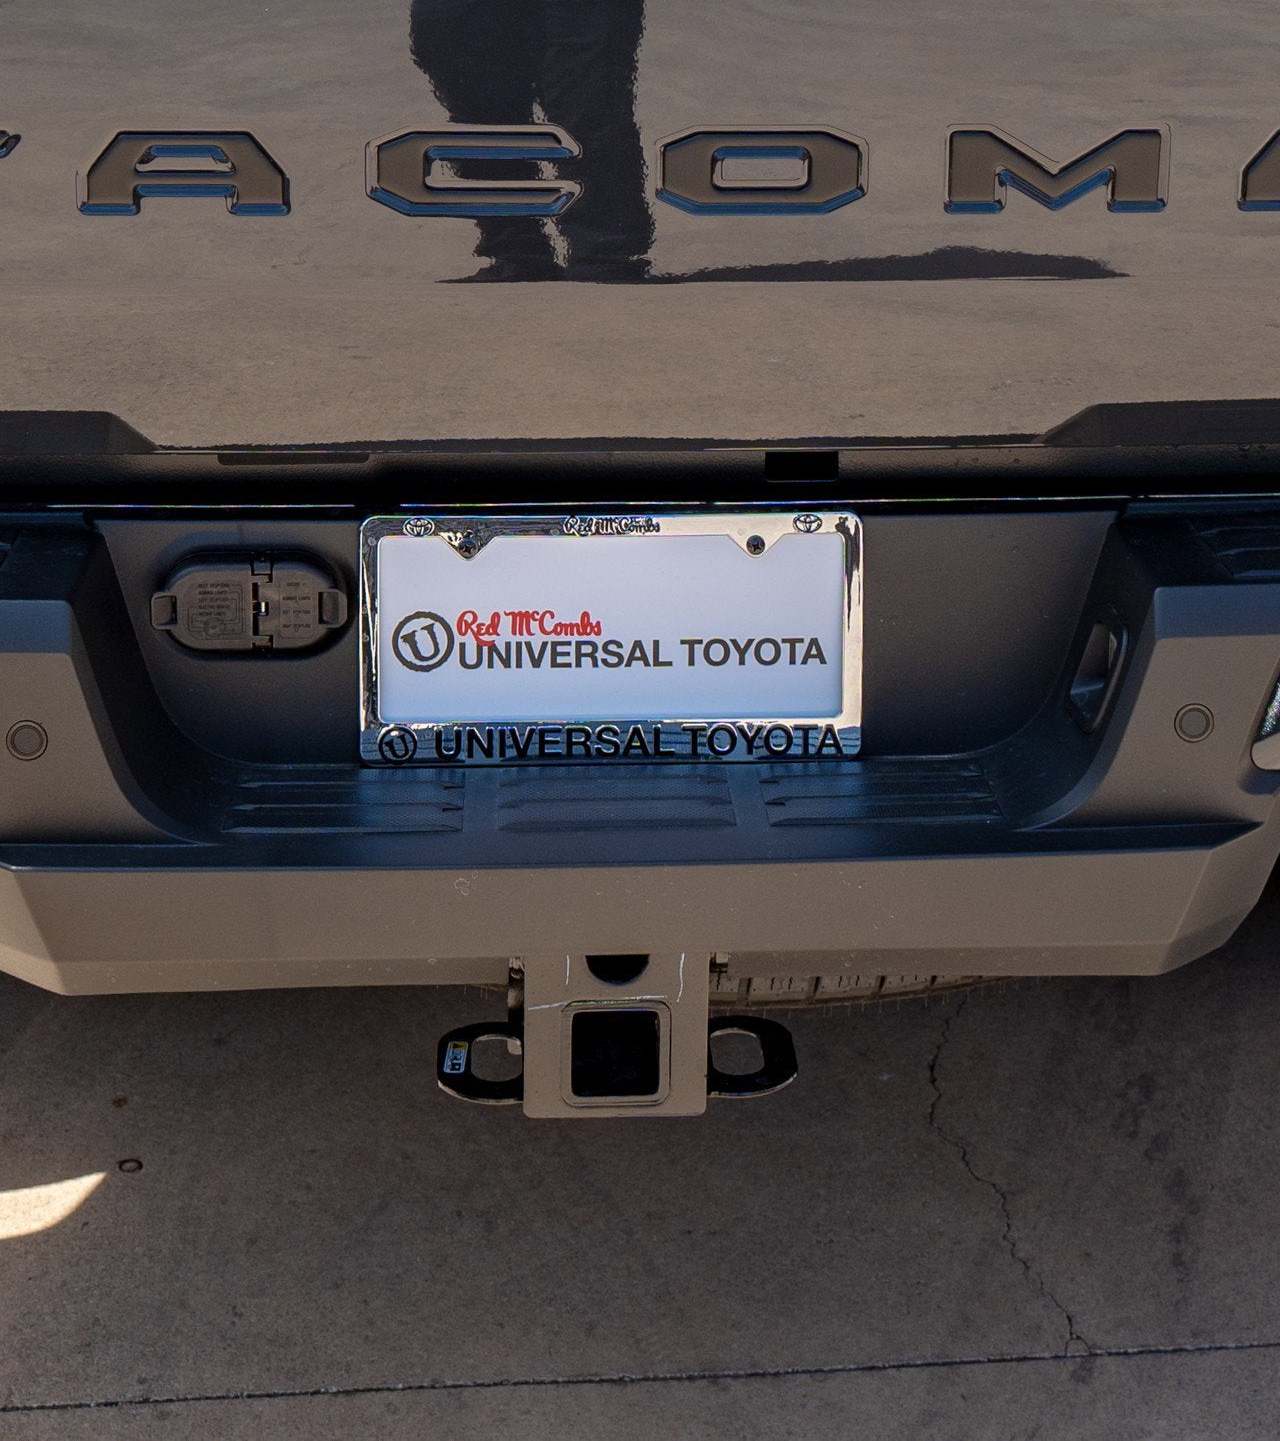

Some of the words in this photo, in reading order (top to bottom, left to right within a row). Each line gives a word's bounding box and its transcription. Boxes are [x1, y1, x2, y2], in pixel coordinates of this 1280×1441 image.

[564, 515, 593, 536] Red
[456, 610, 501, 647] Red
[503, 610, 602, 637] McCombs
[458, 639, 673, 670] UNIVERSAL
[680, 637, 828, 667] TOYOTA
[434, 723, 675, 758] UNIVERSAL
[680, 723, 844, 757] TOYOTA
